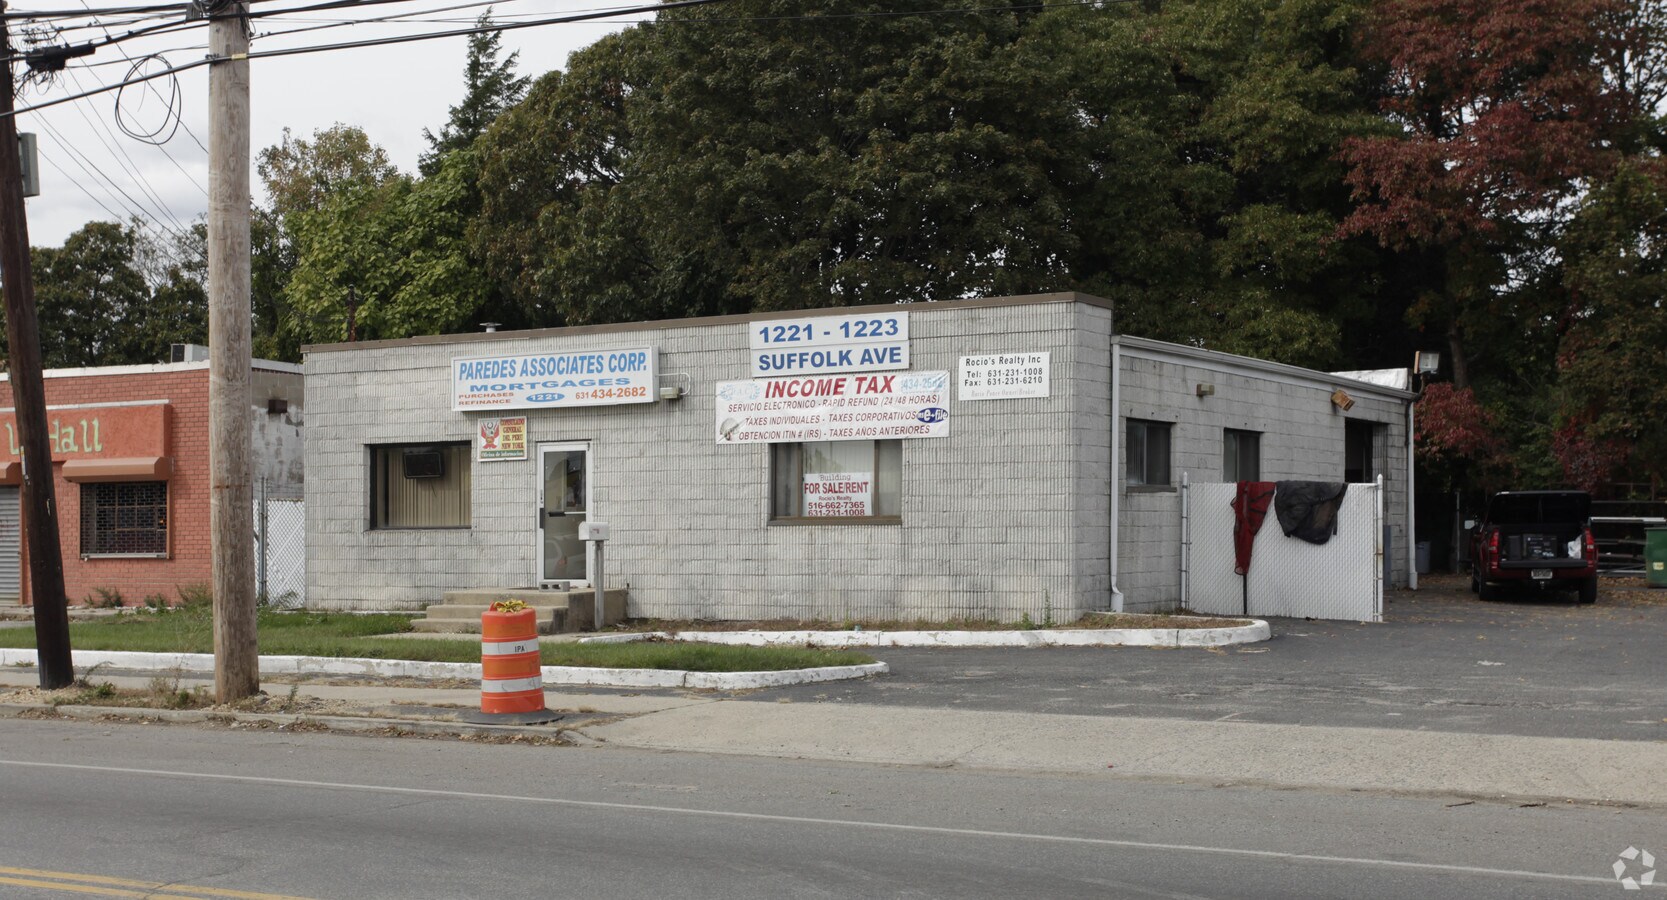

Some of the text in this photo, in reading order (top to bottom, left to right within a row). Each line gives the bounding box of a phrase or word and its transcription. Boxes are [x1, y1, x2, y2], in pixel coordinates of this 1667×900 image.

[759, 323, 813, 343] 1221
[839, 318, 899, 338] 1223
[759, 346, 902, 371] SUFFOLK AVE
[965, 355, 1041, 366] Rocio's Realty Inc
[459, 352, 647, 380] PAREDES ASSOCIATES CORP.
[987, 367, 1043, 377] 631-231-1008
[470, 378, 631, 392] MORTGAGES
[765, 378, 847, 399] INCOME
[855, 375, 896, 395] TAX
[964, 376, 1043, 387] Fax: 631-231-6210
[530, 393, 560, 401] 1221
[591, 386, 646, 399] 434-2682
[728, 402, 761, 413] SERVICIO
[763, 400, 816, 411] ELECTRONICO
[822, 399, 846, 408] RAPID
[847, 397, 879, 407] REFUND
[908, 394, 940, 405] HORAS)
[745, 416, 768, 426] TAXES
[769, 415, 820, 425] INDIVIDUALES
[828, 412, 854, 422] TAXES
[855, 411, 916, 421] CORPORATIVOS
[739, 430, 781, 440] OBTENCION
[782, 430, 796, 439] ITIN
[829, 427, 853, 437] TAXES
[879, 425, 930, 436] ANTERIORES
[804, 481, 869, 494] FOR SALE/RENT
[808, 501, 865, 509] 516-662-7365
